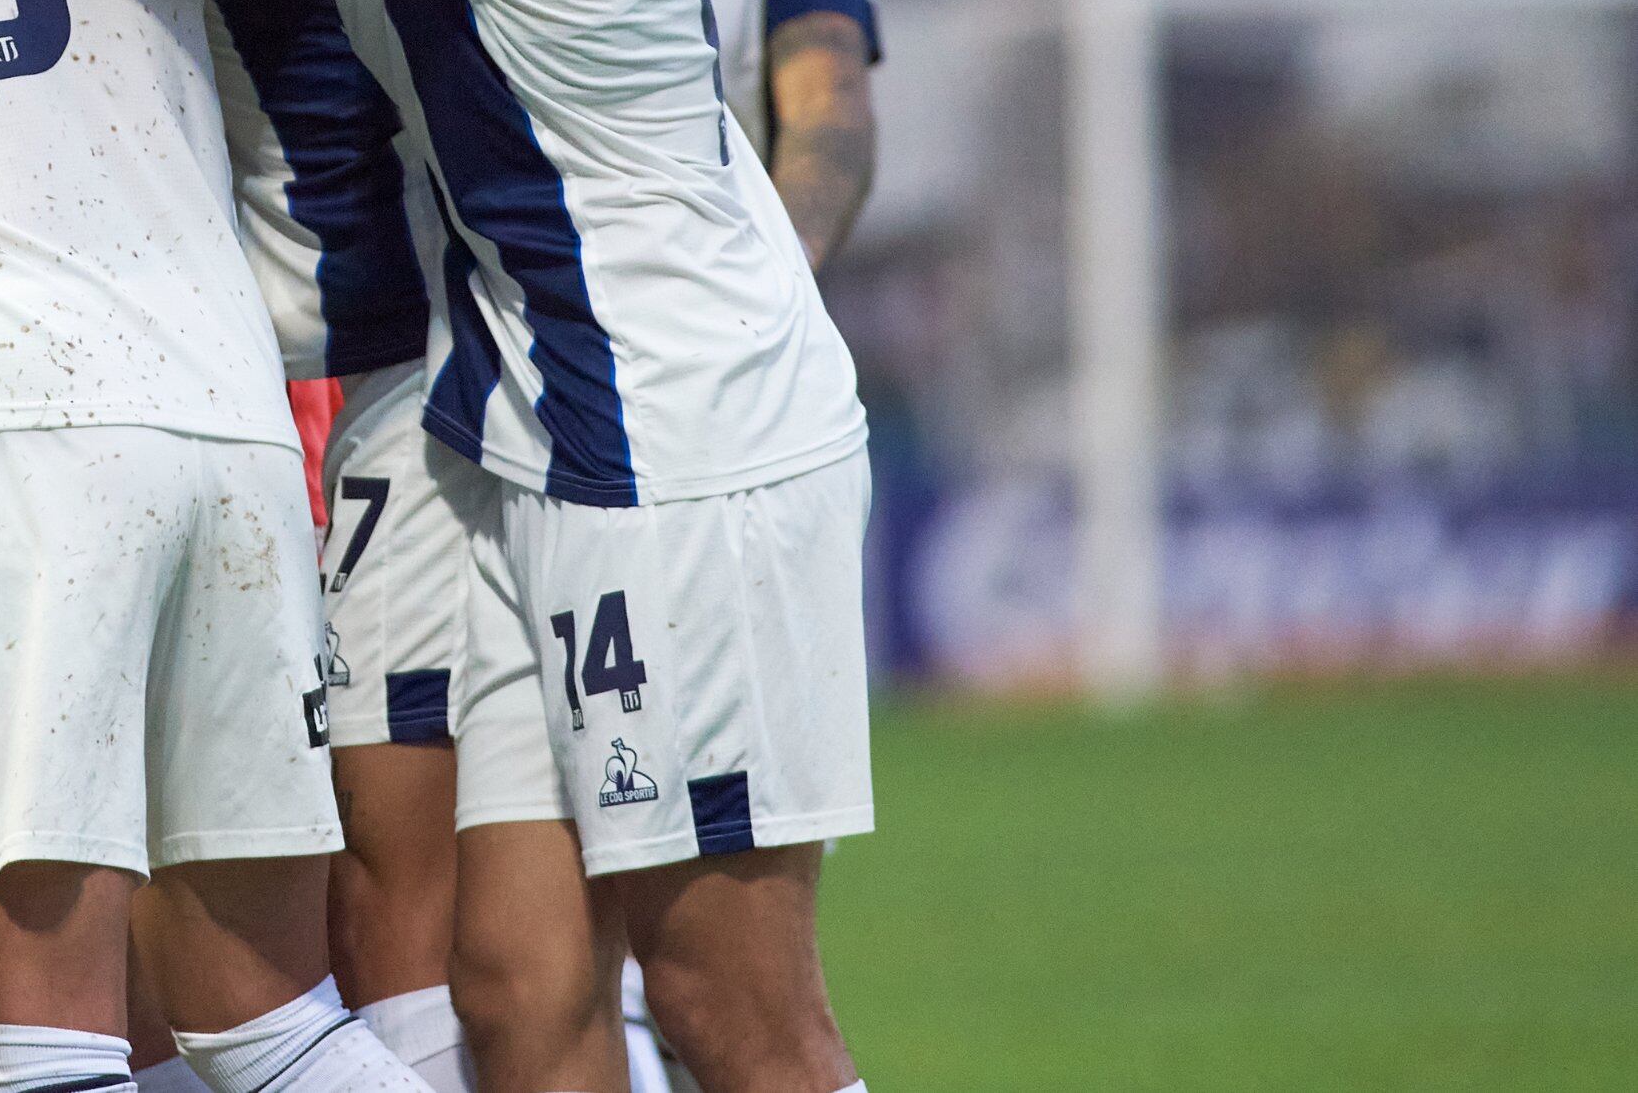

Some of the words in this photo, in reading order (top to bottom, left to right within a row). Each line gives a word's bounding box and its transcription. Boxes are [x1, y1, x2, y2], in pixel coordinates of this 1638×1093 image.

[319, 476, 390, 597] 7
[550, 590, 647, 731] 14
[624, 787, 656, 801] SPORTIF
